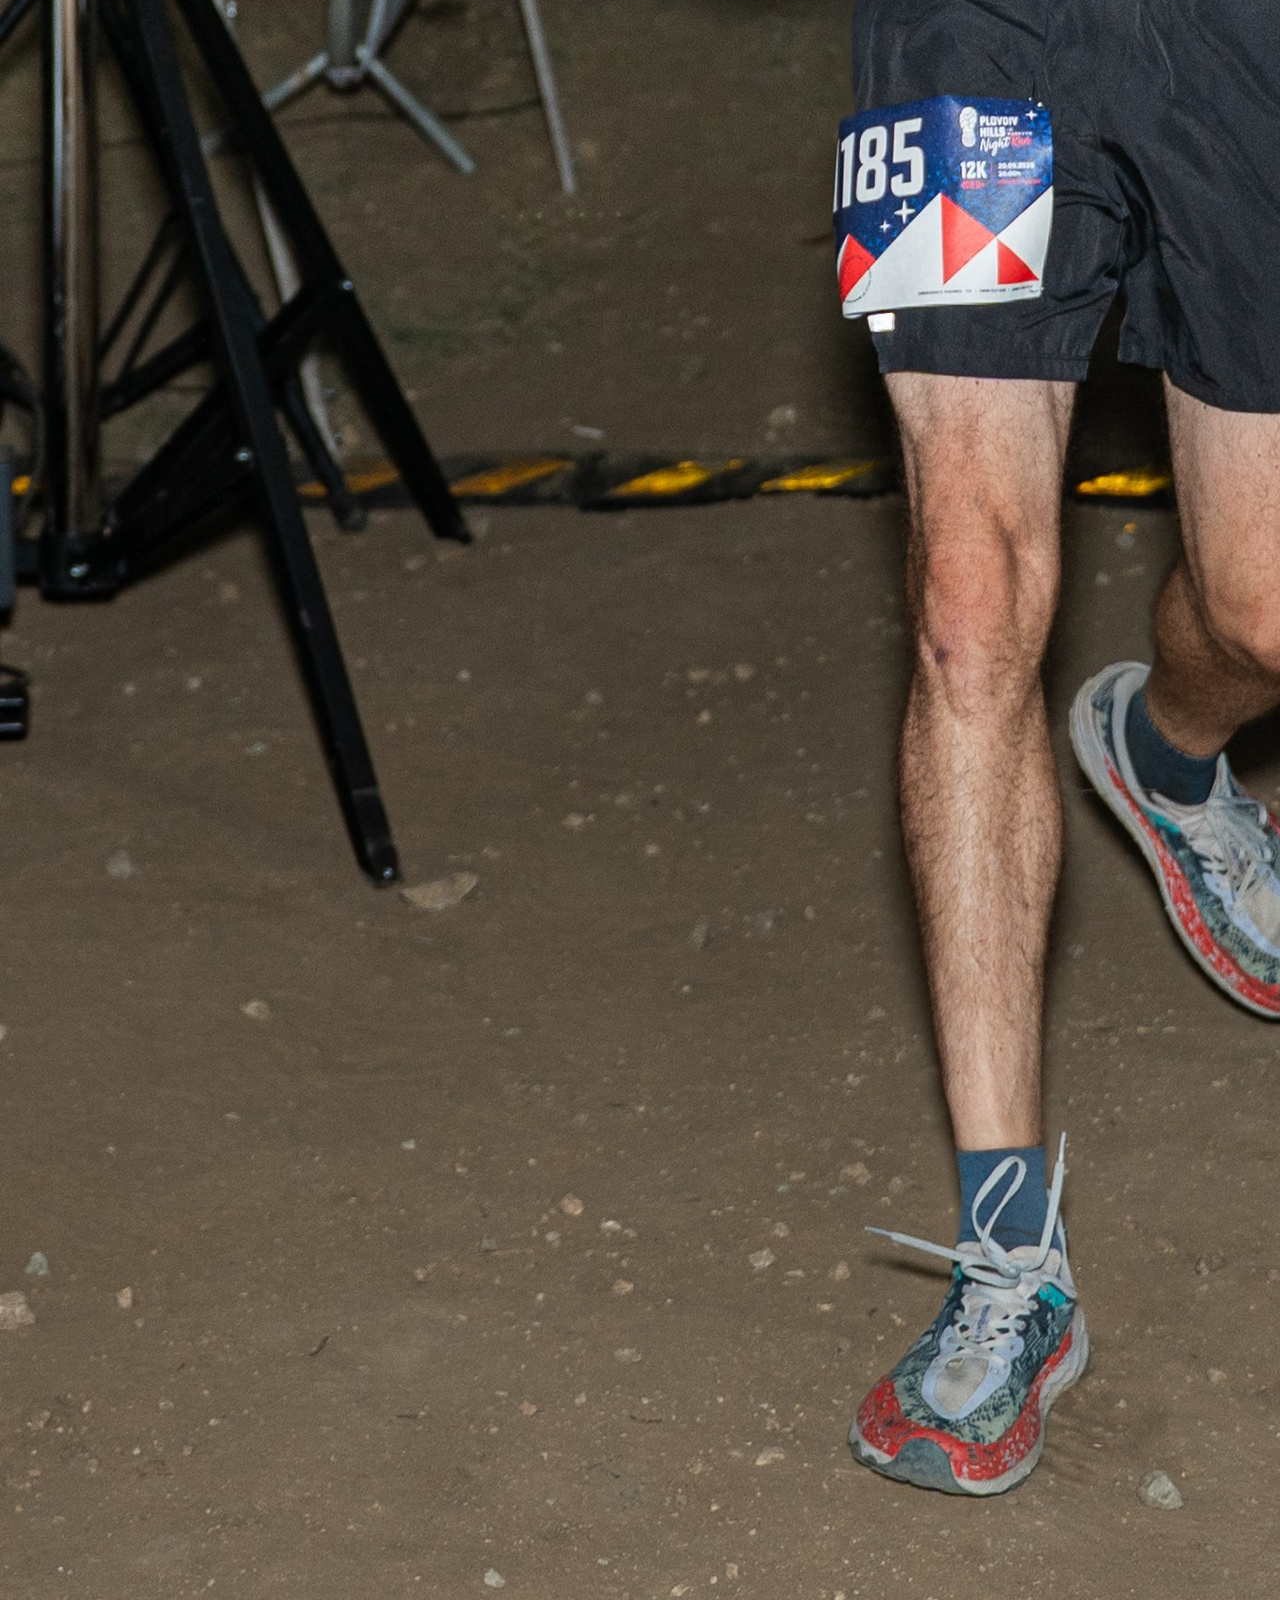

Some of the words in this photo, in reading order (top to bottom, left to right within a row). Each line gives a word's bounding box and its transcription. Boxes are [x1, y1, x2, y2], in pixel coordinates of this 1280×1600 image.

[980, 126, 1006, 138] HILLS
[980, 136, 1010, 157] Night
[833, 116, 924, 213] 185
[960, 160, 988, 179] 12K
